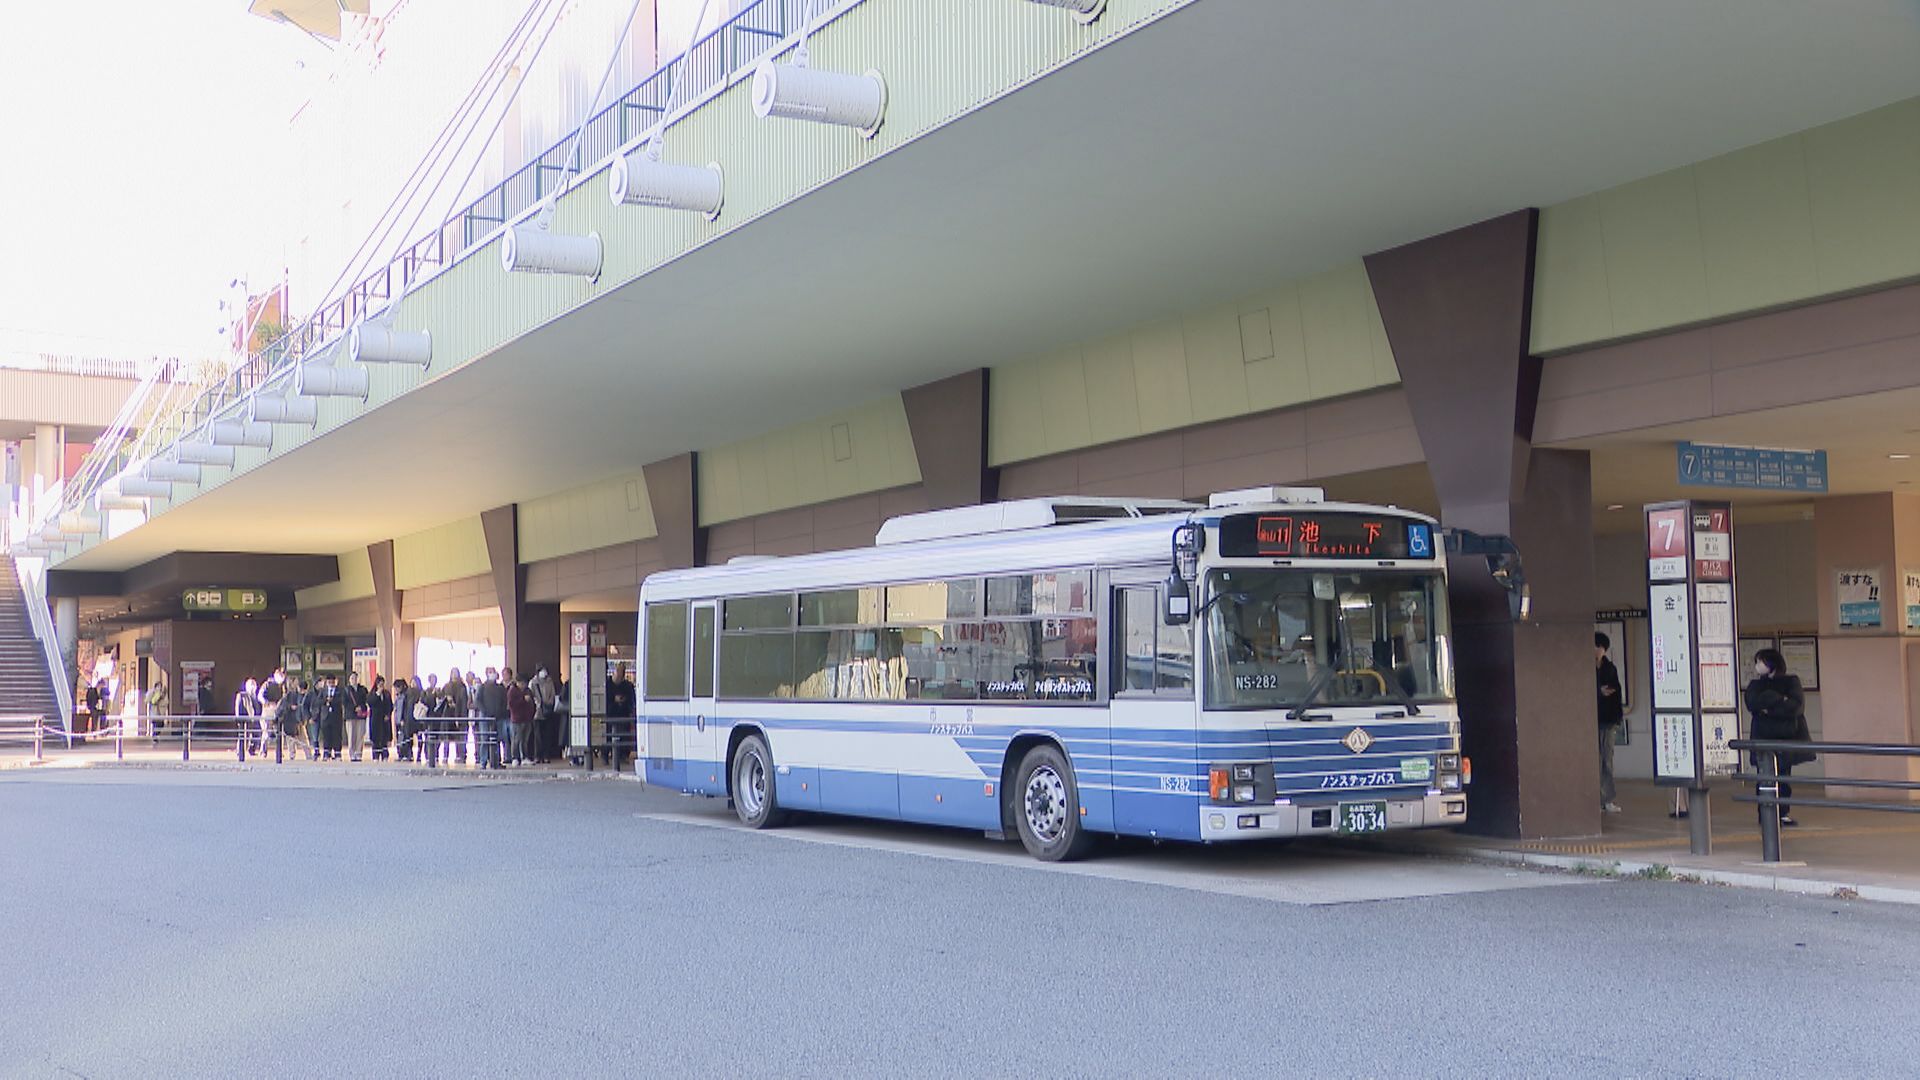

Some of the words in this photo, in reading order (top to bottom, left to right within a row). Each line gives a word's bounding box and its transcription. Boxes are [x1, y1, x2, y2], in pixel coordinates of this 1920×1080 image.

[1685, 455, 1696, 475] 7
[1714, 512, 1724, 530] 7
[1658, 519, 1676, 551] 7
[574, 627, 583, 642] 8
[1320, 773, 1396, 788] ノンステップバス
